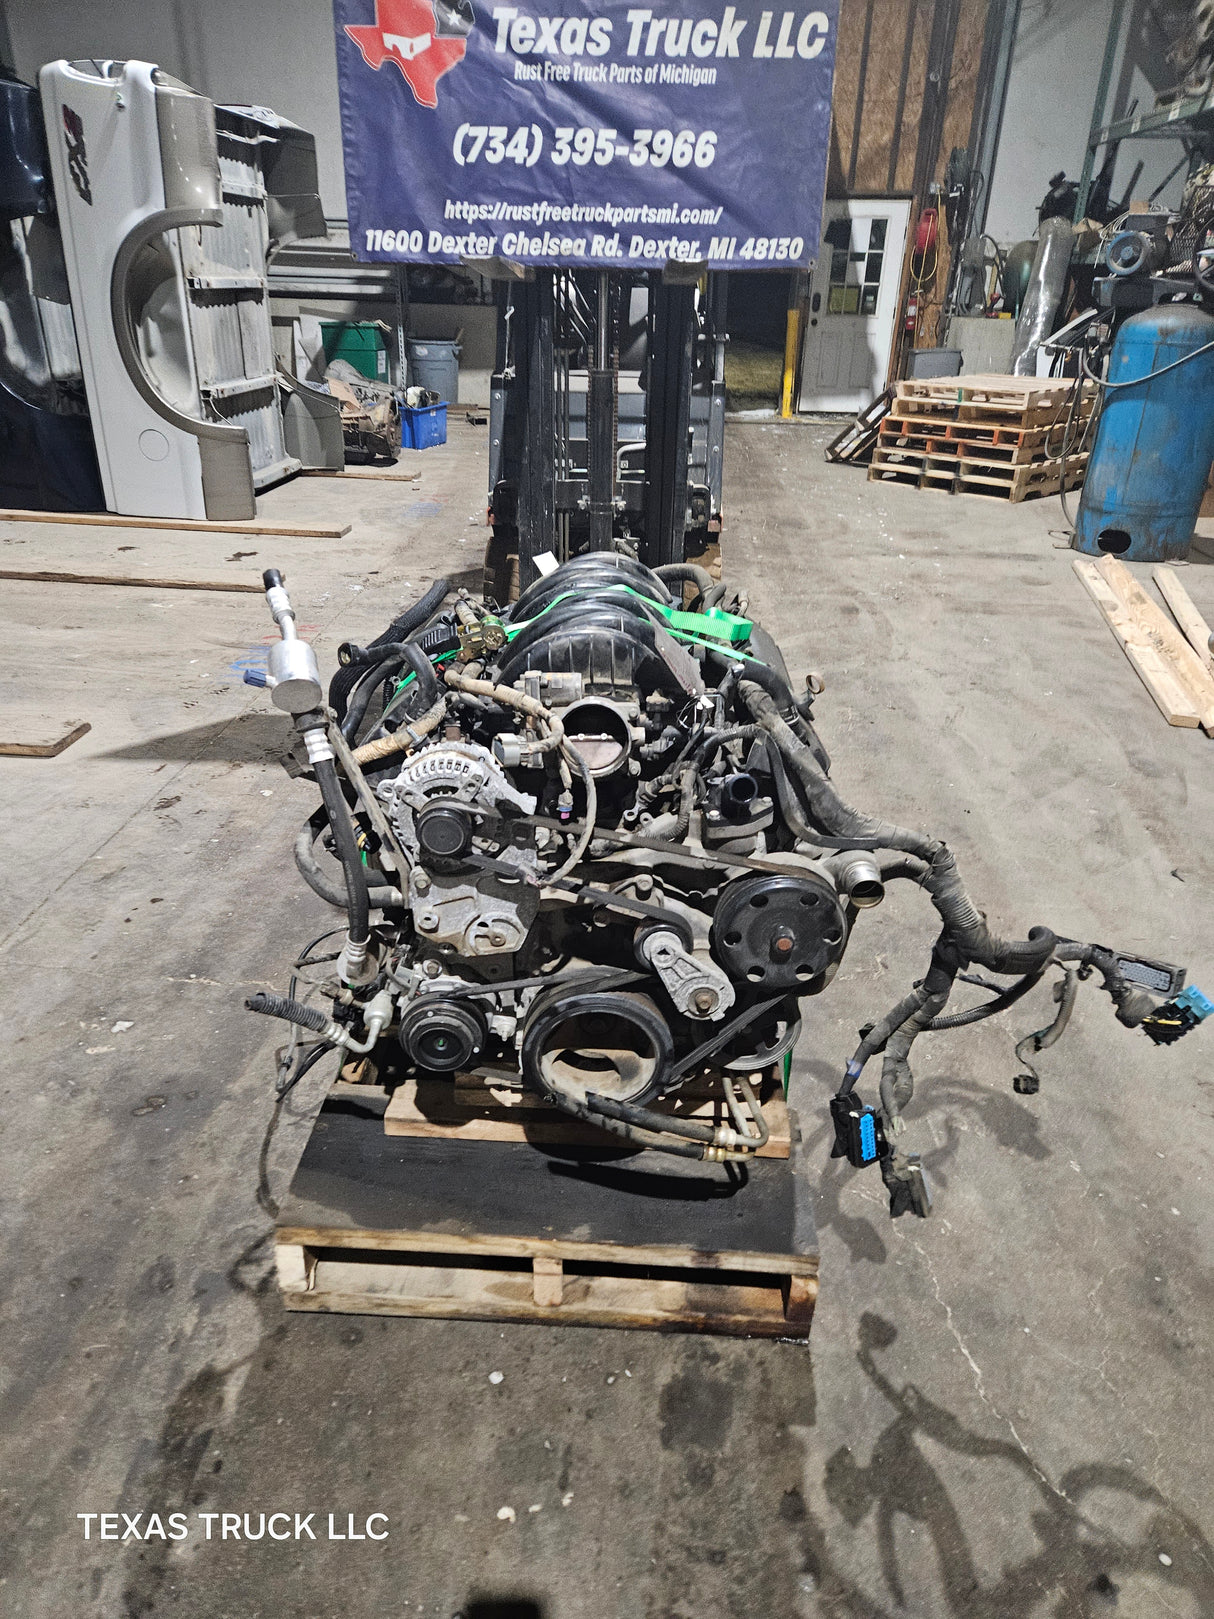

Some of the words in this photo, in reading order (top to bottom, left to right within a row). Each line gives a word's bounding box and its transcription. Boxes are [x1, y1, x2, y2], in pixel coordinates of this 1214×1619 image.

[492, 7, 613, 57] Texas
[626, 6, 748, 58] Truck
[752, 11, 829, 60] LLC
[514, 60, 543, 81] Rust
[543, 60, 571, 82] Free
[572, 61, 609, 83] Truck
[609, 62, 642, 84] Parts
[644, 63, 659, 84] of
[659, 63, 717, 87] Michigan
[452, 122, 543, 167] (734)
[551, 127, 718, 168] 395-3966
[444, 199, 724, 227] https://rustfreetruckpartsmi.com/
[365, 228, 424, 253] 11600
[427, 230, 498, 256] Dexter
[502, 230, 587, 256] Chelsea
[590, 232, 623, 258] Rd.
[707, 236, 737, 260] MI
[739, 236, 804, 261] 48130
